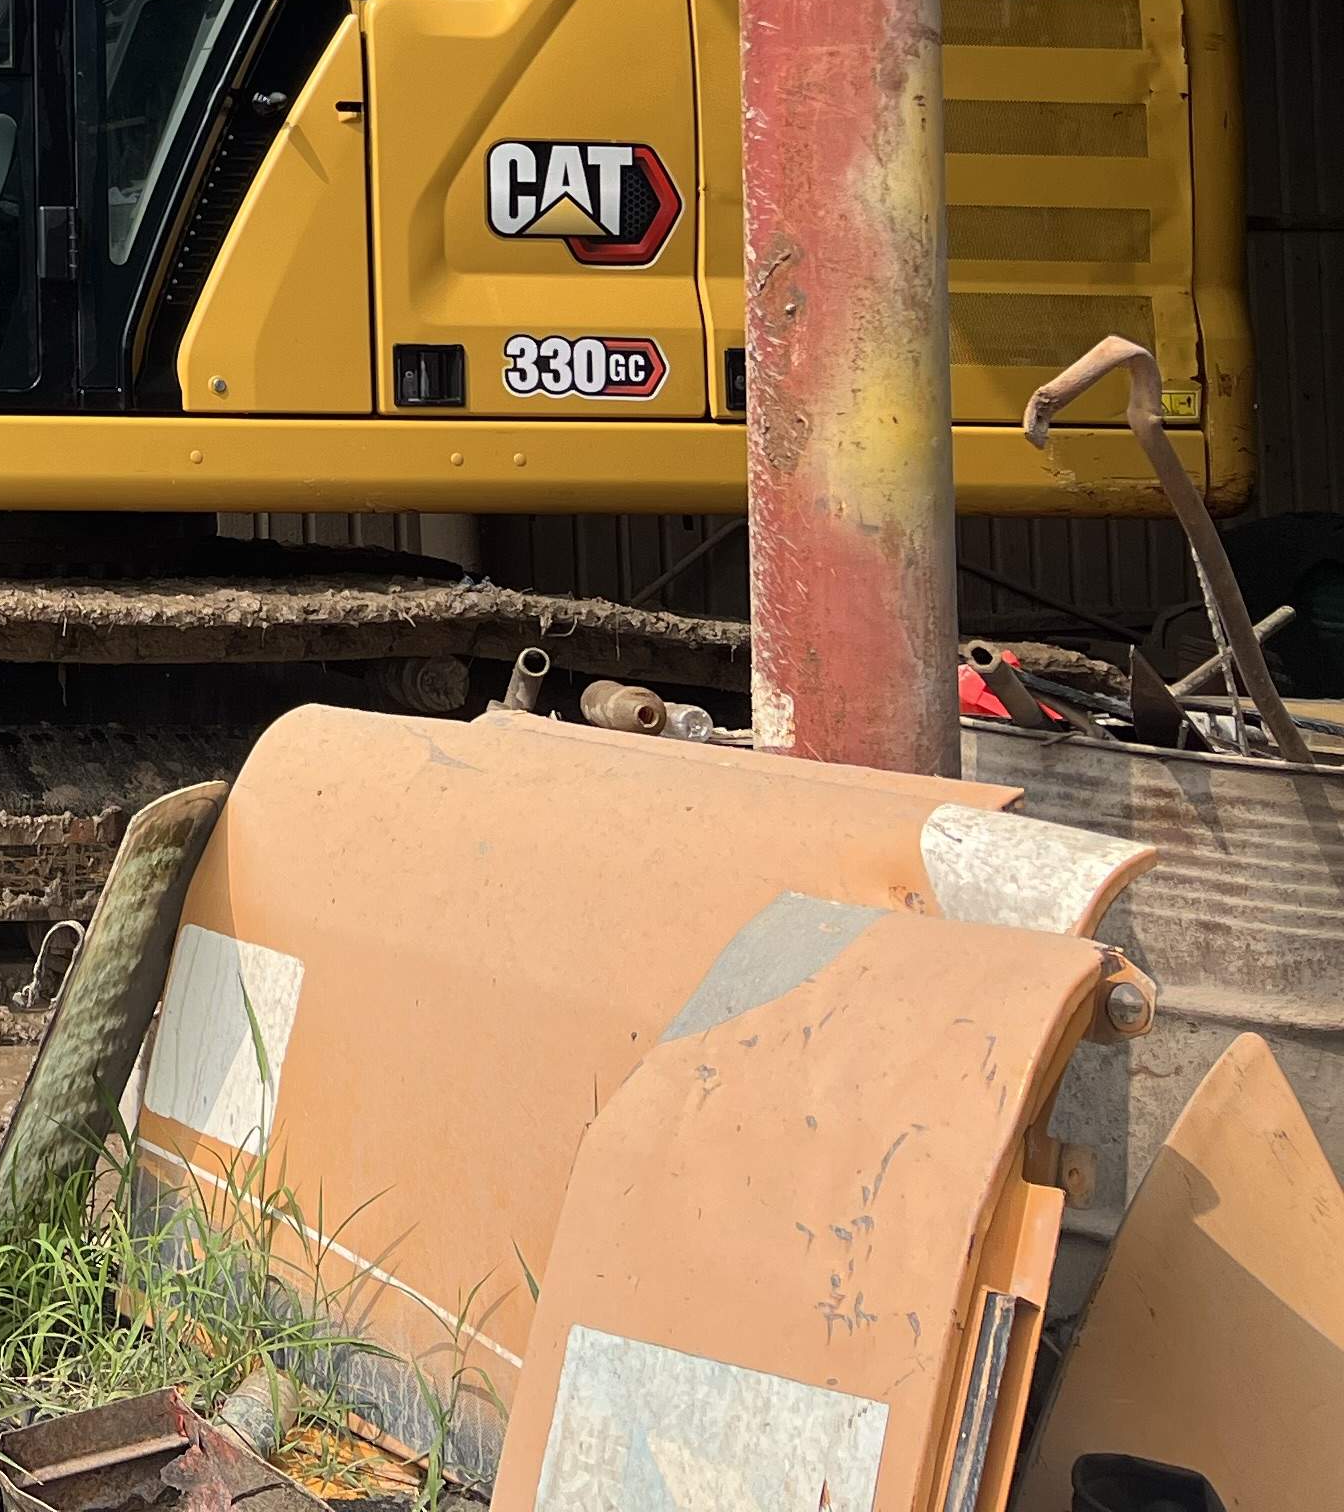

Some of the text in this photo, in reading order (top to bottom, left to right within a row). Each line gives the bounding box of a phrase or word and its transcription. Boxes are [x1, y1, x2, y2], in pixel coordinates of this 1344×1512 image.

[489, 142, 633, 236] CAT
[505, 336, 646, 393] 330 GC
